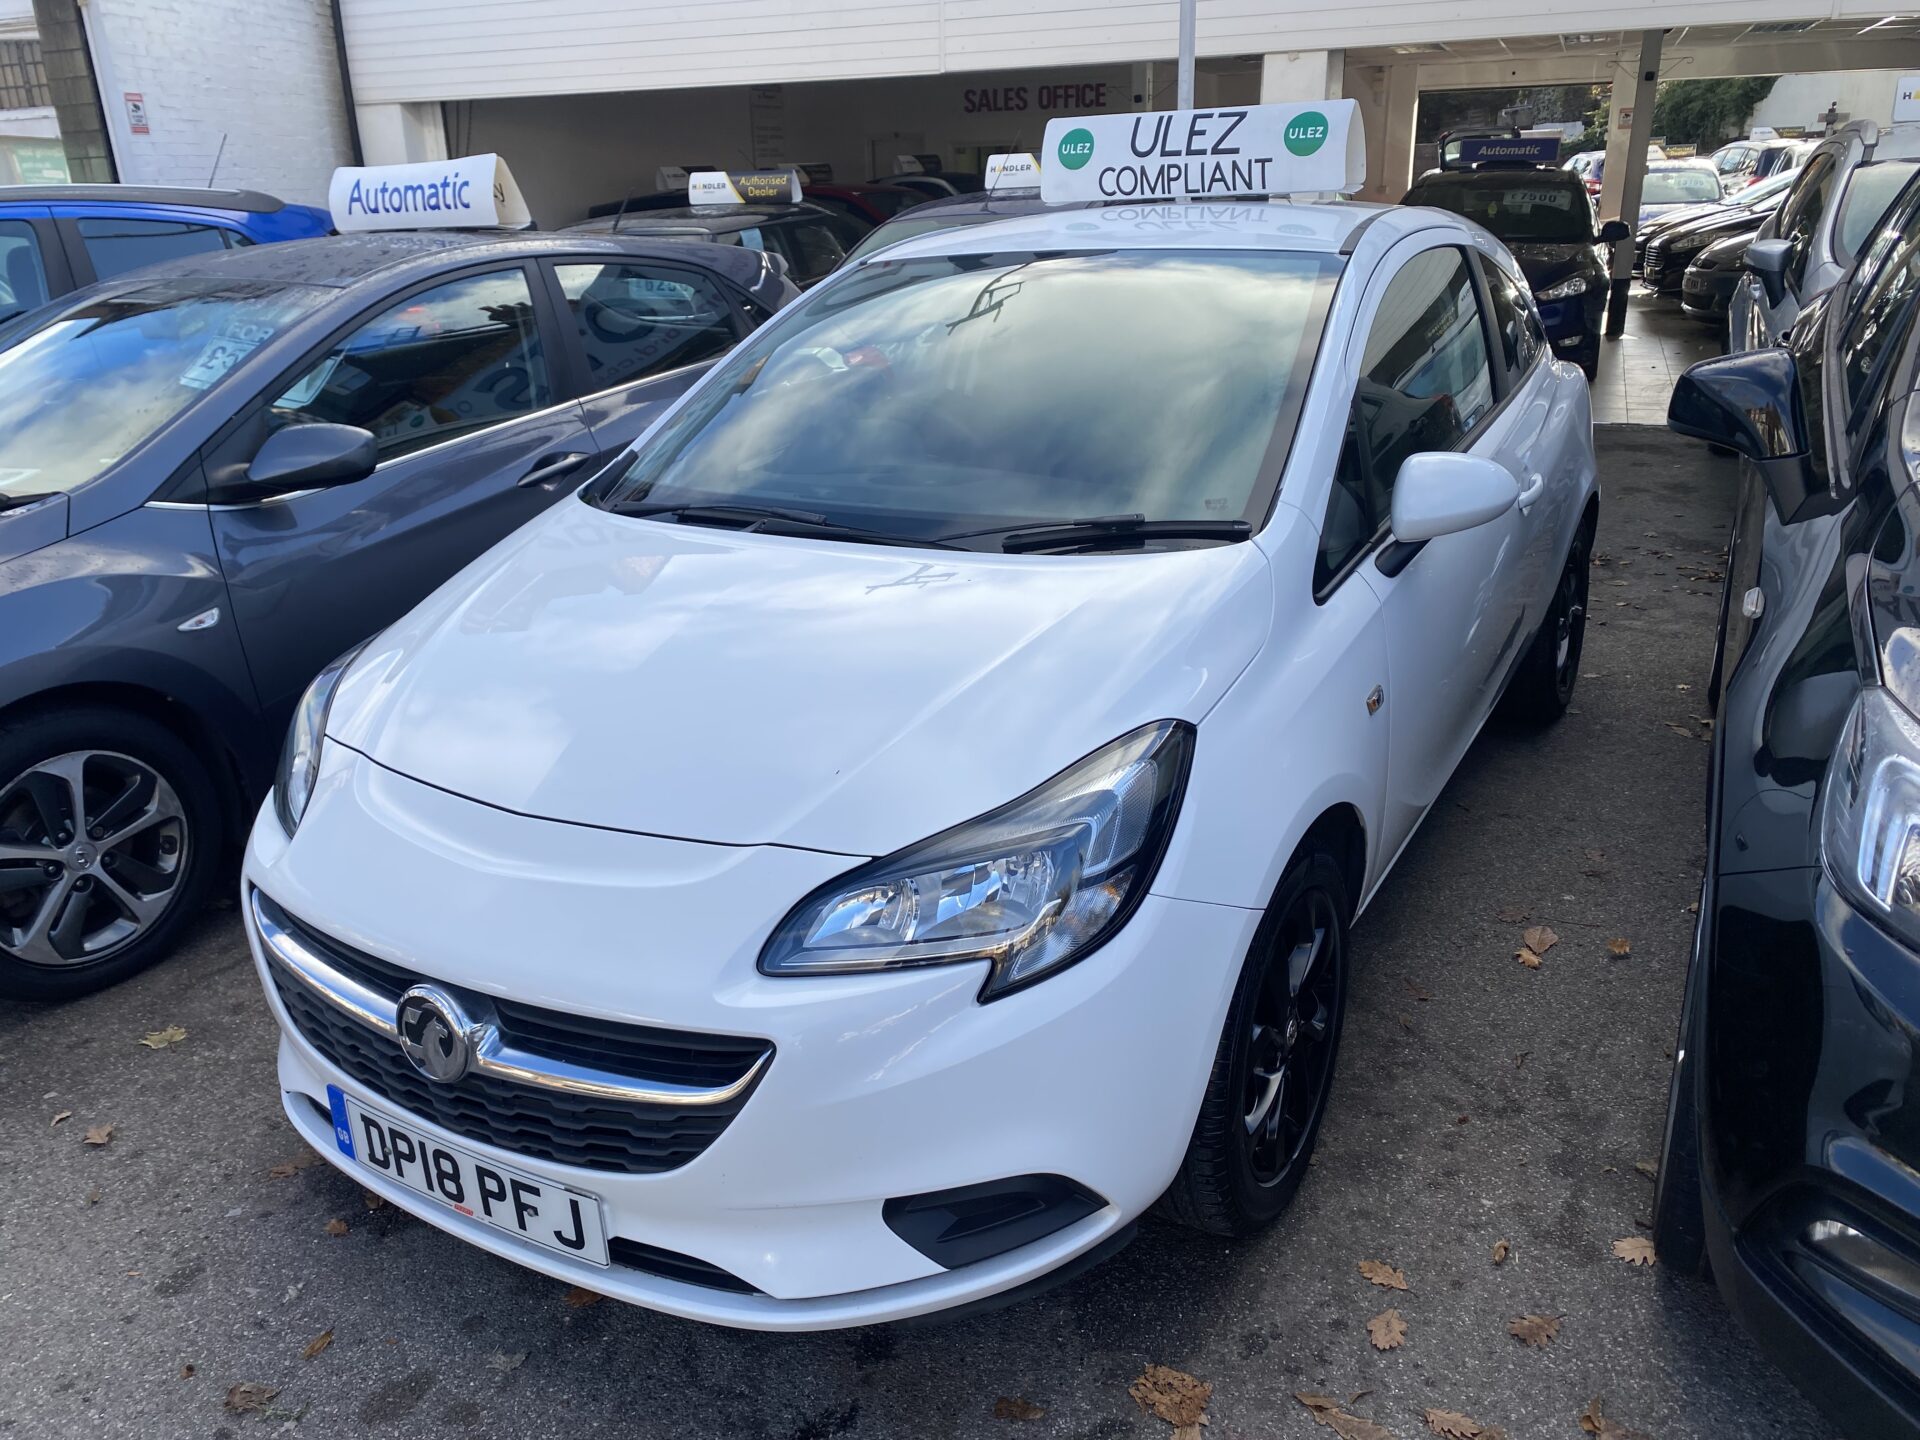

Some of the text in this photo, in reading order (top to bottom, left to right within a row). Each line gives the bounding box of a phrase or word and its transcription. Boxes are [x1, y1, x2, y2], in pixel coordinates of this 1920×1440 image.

[964, 83, 1107, 113] SALES OFFICE
[1130, 111, 1249, 158] ULEZ
[1288, 126, 1325, 139] ULEZ
[1062, 143, 1091, 154] ULEZ
[1478, 144, 1541, 155] Automatic
[739, 175, 788, 185] Authorised
[1099, 158, 1273, 196] COMPLIANT
[348, 172, 471, 215] Automatic
[747, 186, 778, 196] Dealer
[337, 1127, 350, 1145] GB
[360, 1113, 585, 1251] DP18 PFJ
